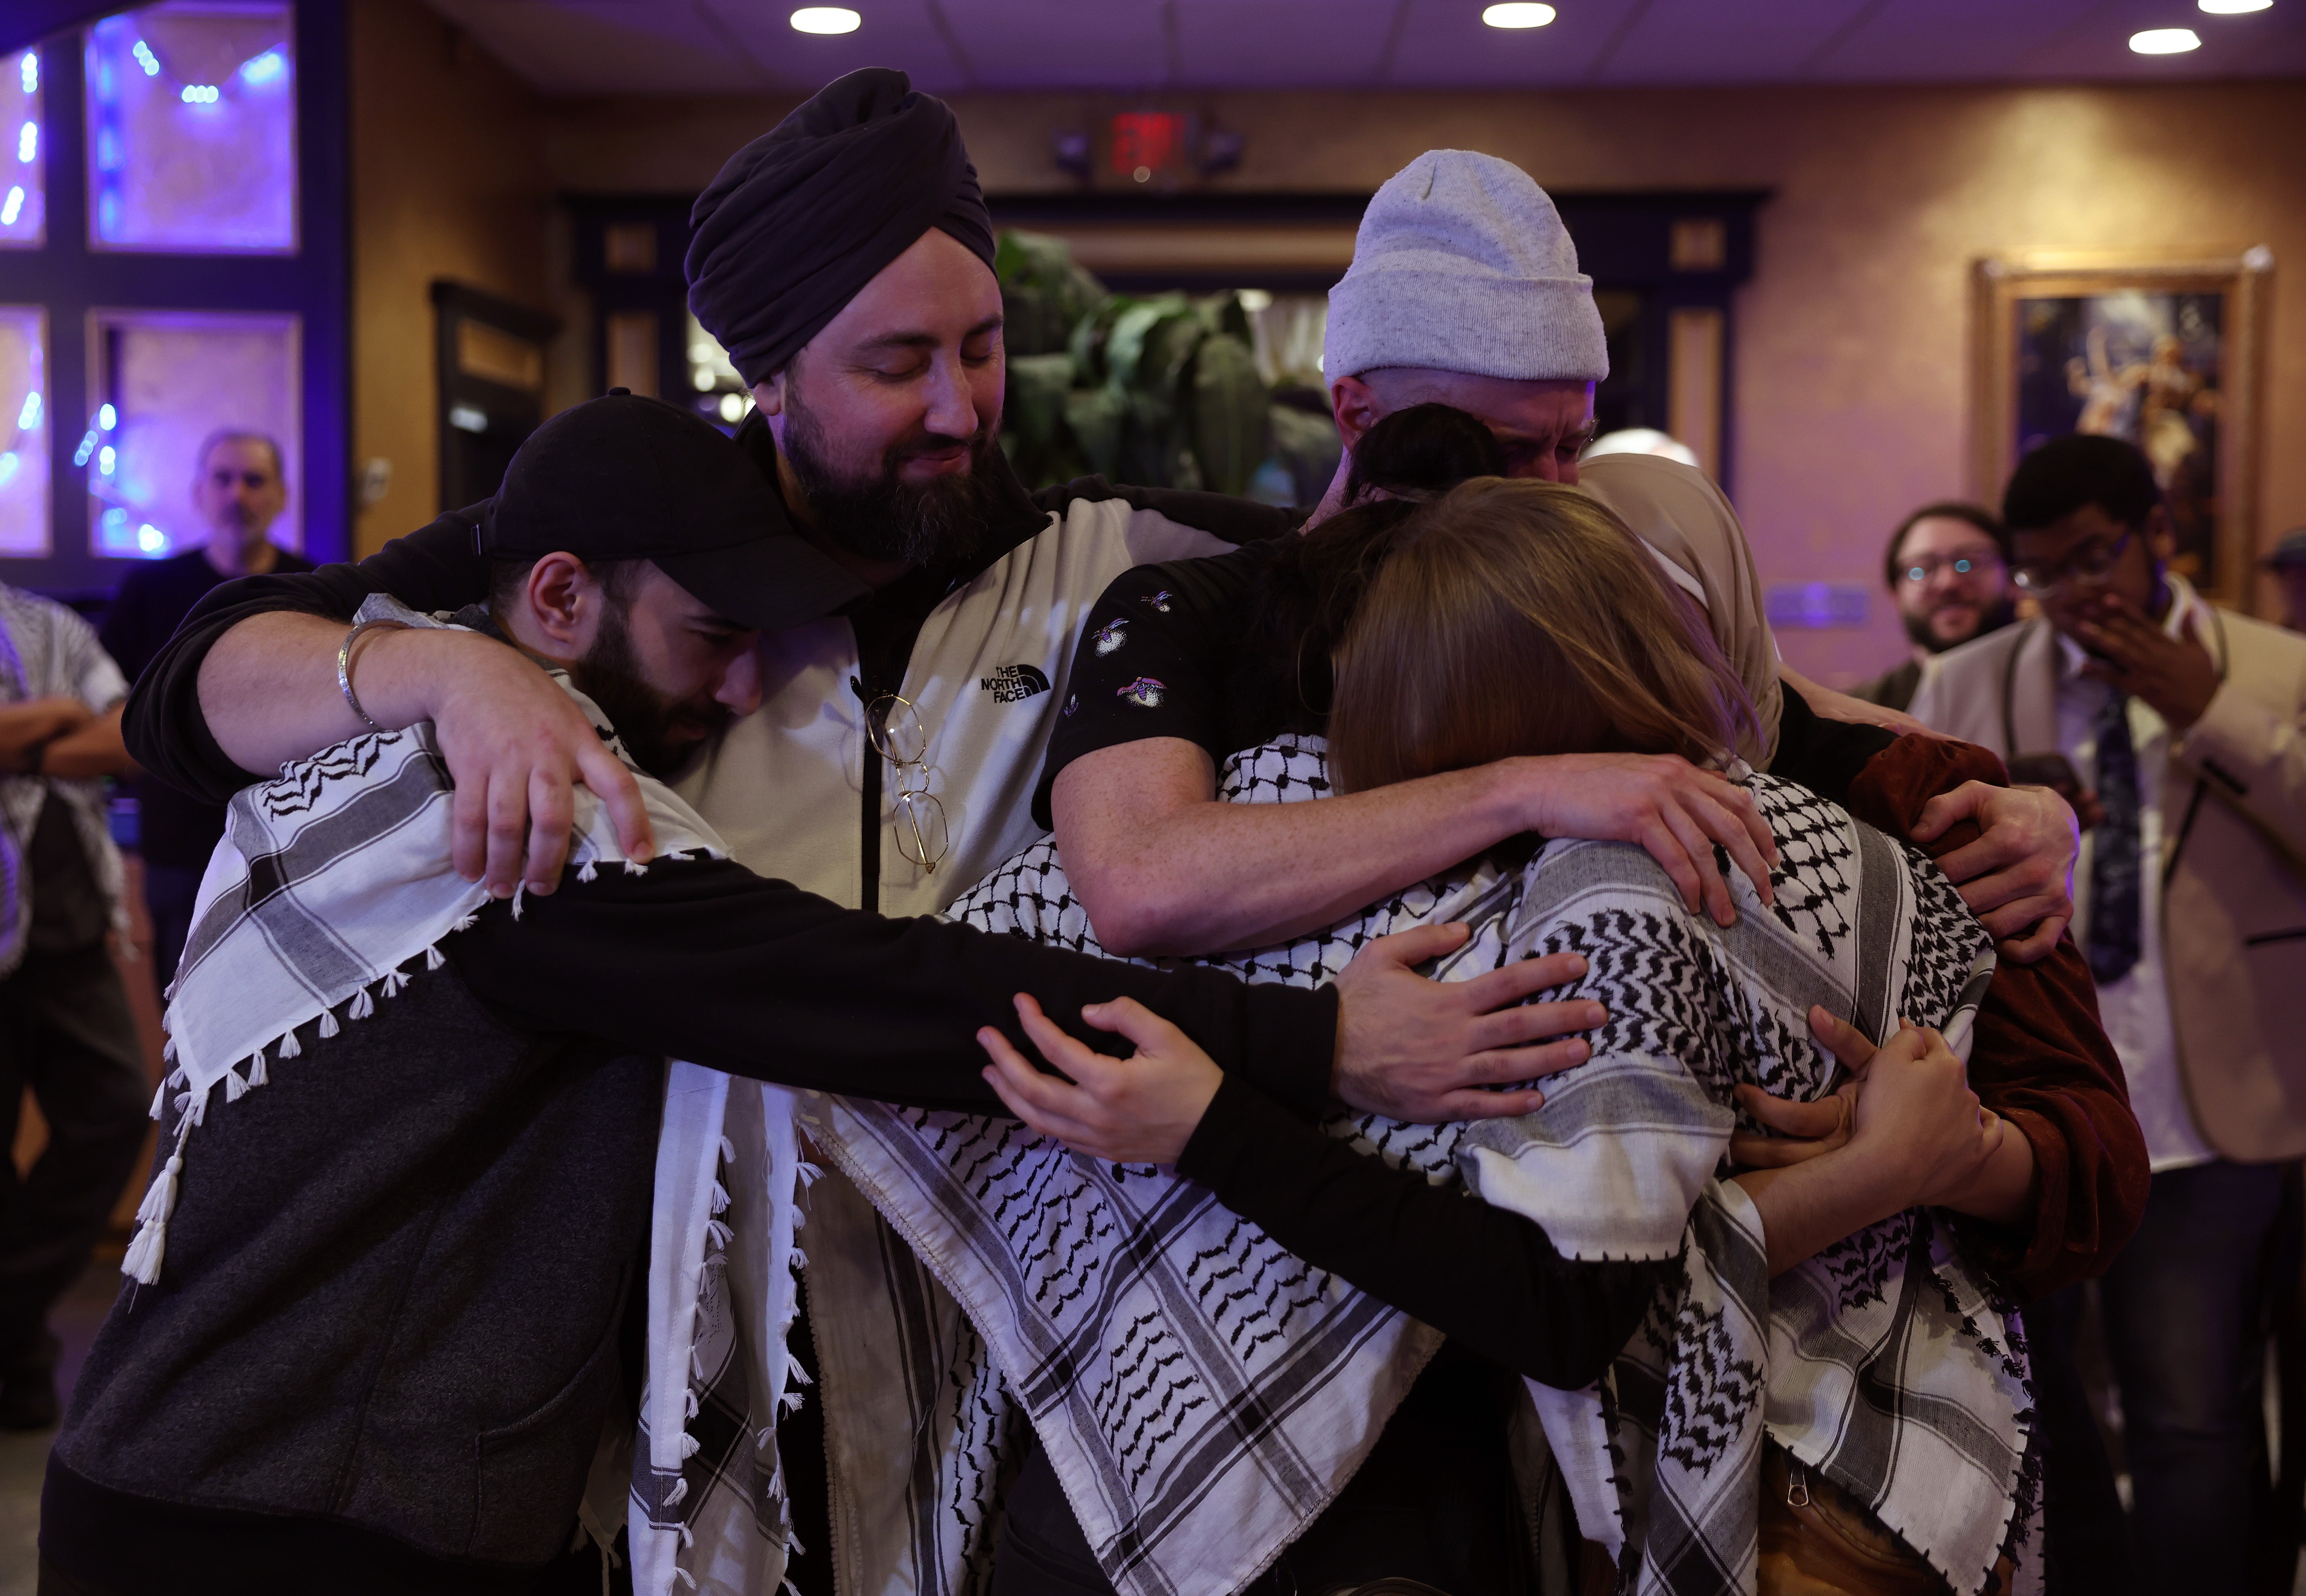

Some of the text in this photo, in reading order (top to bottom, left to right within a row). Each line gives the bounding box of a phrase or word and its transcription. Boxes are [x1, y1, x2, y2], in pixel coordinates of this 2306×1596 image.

[996, 666, 1018, 678] THE
[981, 677, 1022, 690] NORTH
[994, 688, 1025, 703] FACE
